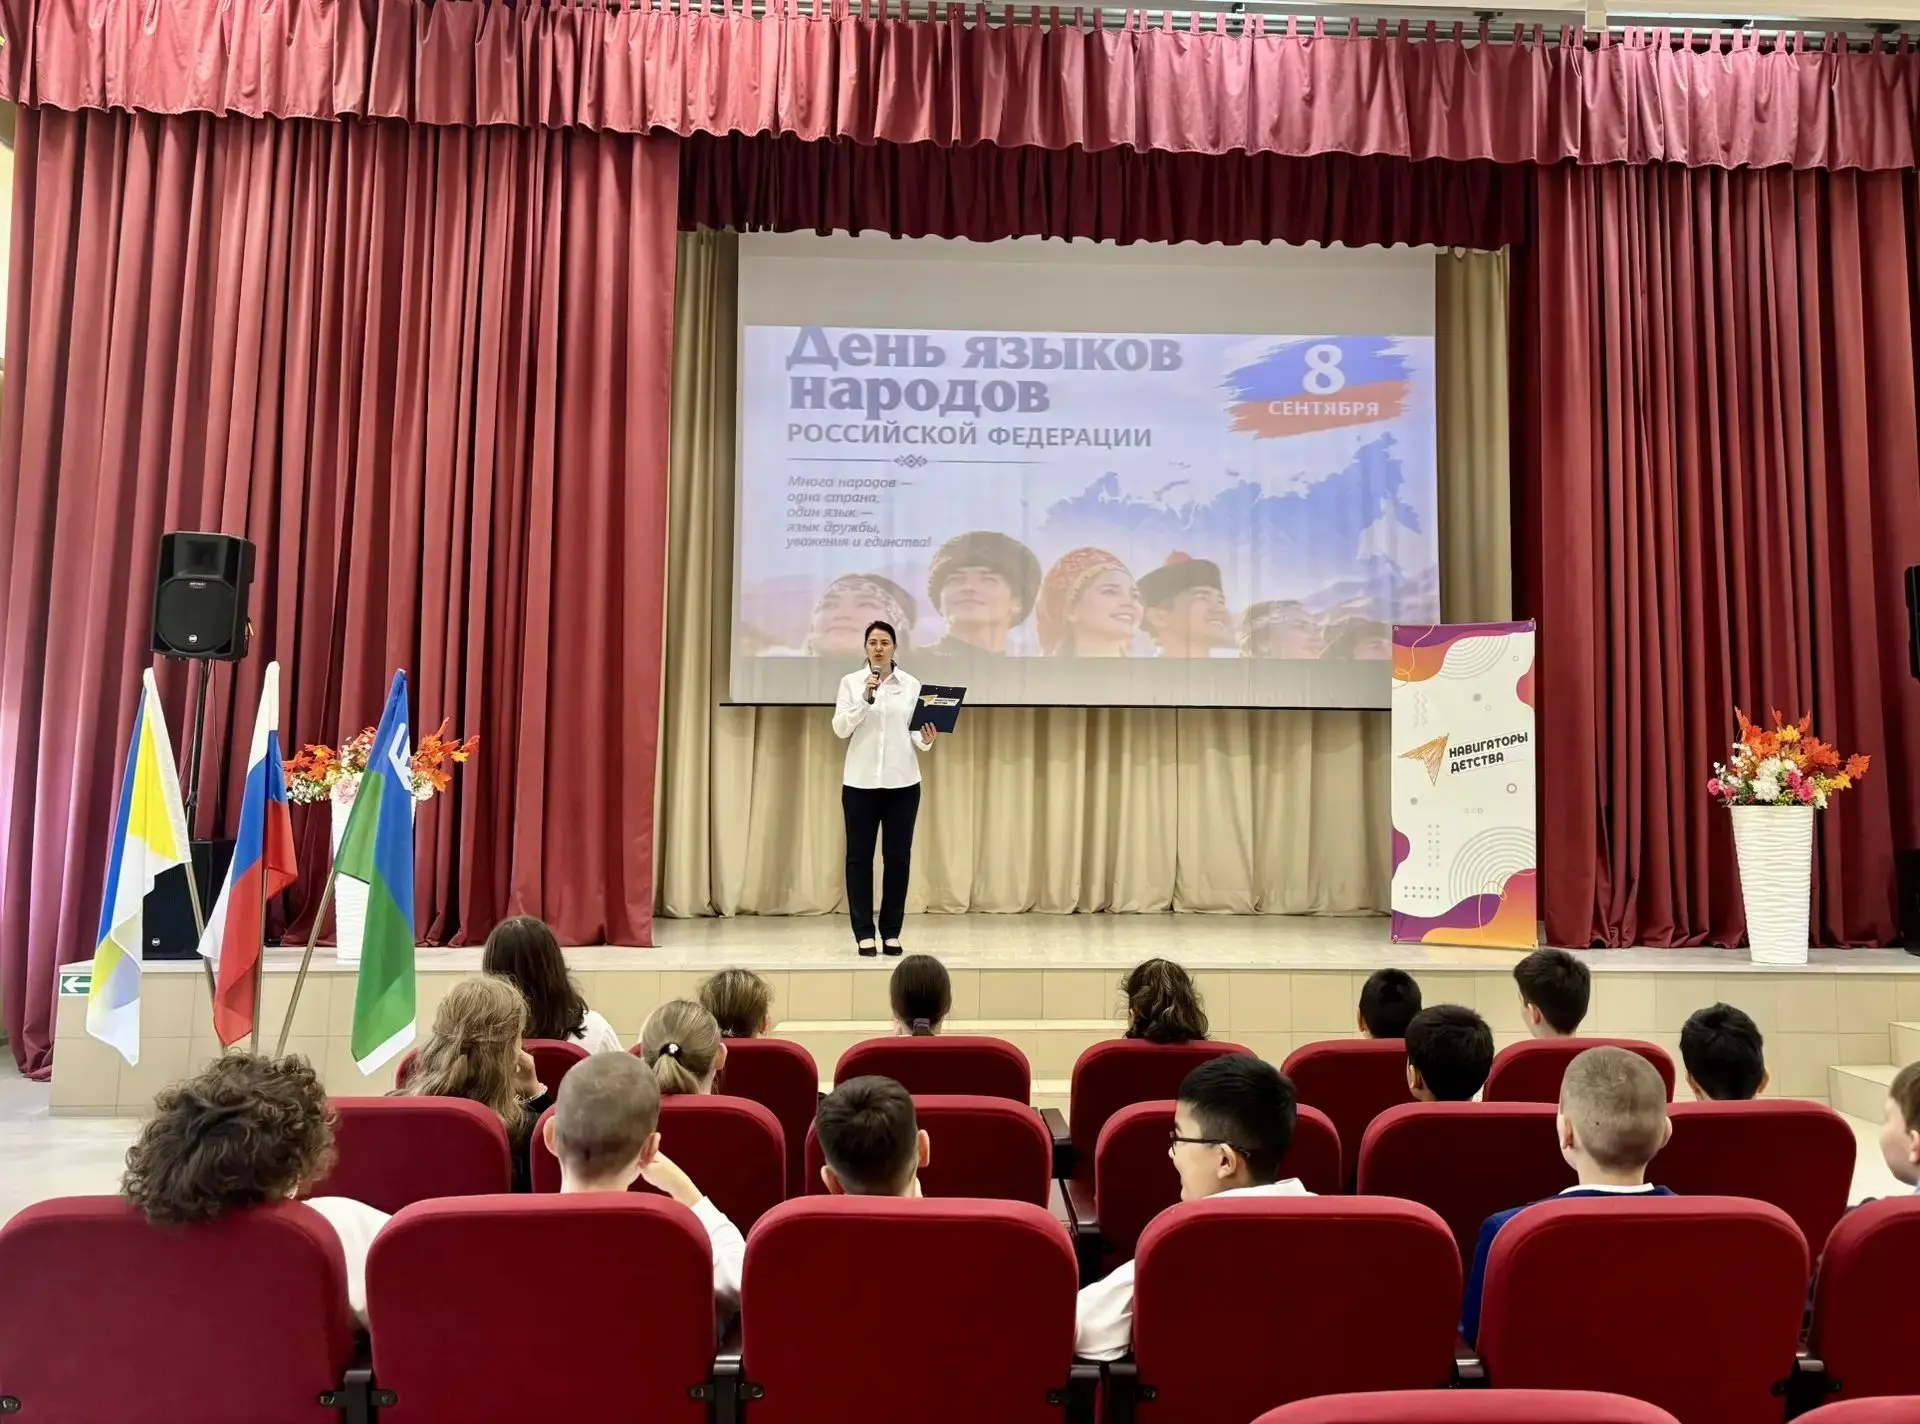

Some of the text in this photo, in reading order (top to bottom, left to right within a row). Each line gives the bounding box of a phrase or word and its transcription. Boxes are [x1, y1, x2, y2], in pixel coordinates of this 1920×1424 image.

[786, 326, 1184, 371] День языков
[1302, 344, 1346, 395] 8
[789, 376, 1050, 421] народов
[1268, 401, 1380, 416] СЕНТЯБРЯ
[787, 420, 1151, 449] РОССИЙСКОЙ ФЕДЕРАЦИИ
[837, 478, 896, 489] народов
[787, 492, 820, 504] одна
[786, 506, 820, 517] один
[823, 509, 857, 518] язык
[786, 523, 820, 532] язык
[785, 536, 931, 549] уважения и единства!
[1449, 731, 1528, 758] НАВИГАТОРЫ
[1450, 752, 1505, 774] ДЕТСТВА
